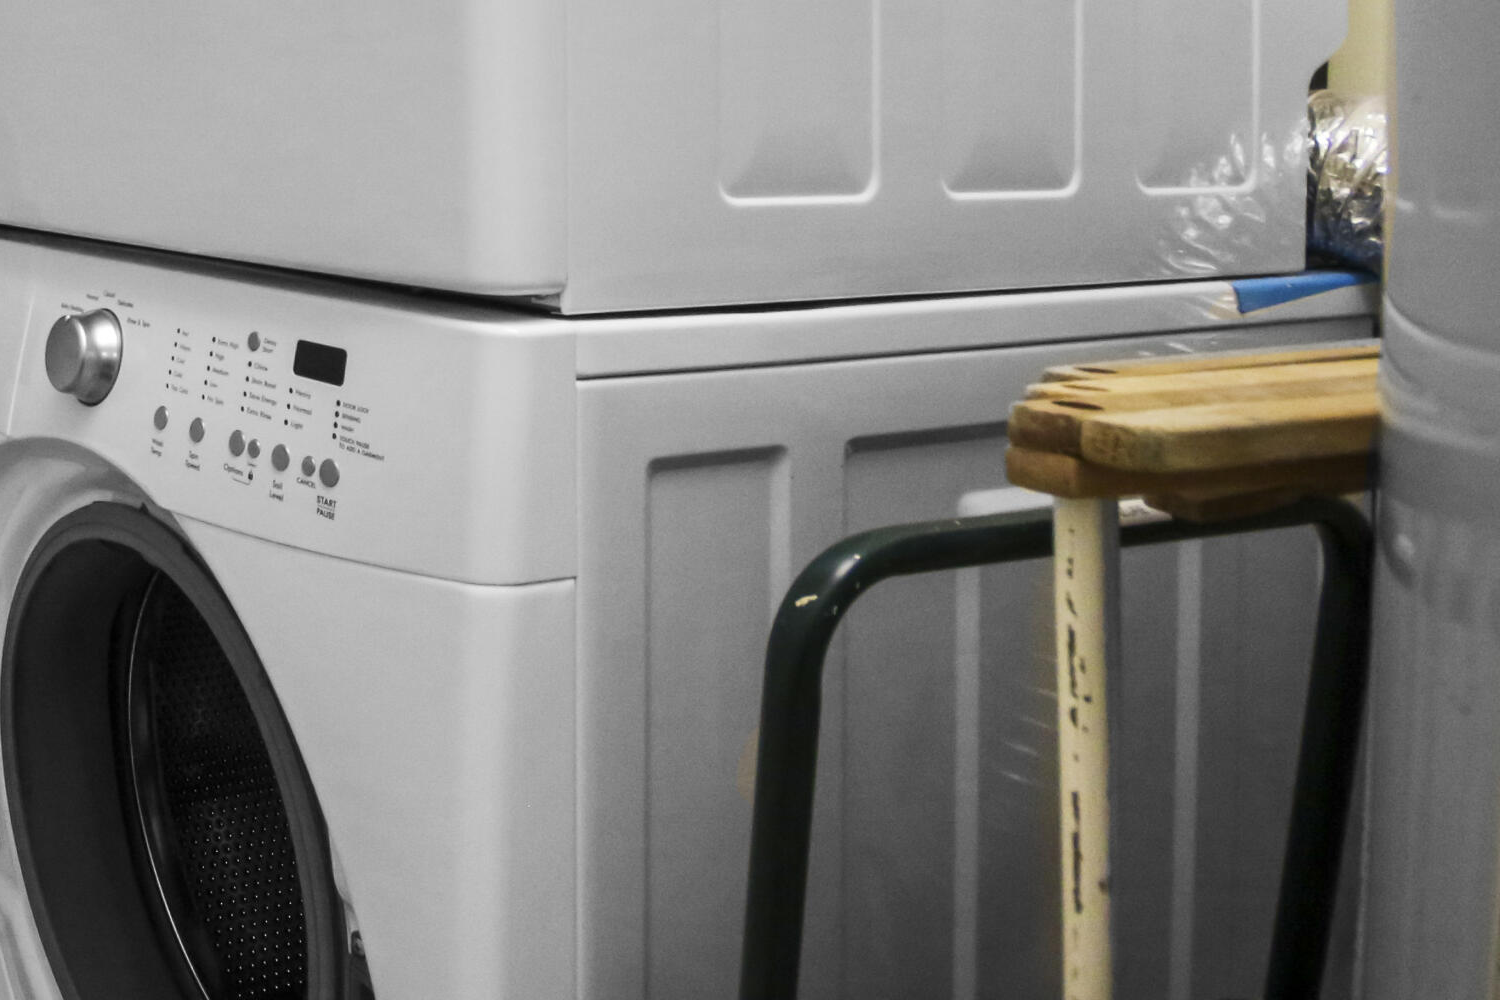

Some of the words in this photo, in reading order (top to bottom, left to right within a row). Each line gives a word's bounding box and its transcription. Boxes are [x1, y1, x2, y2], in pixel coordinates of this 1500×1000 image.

[223, 463, 244, 476] Options
[272, 479, 283, 490] Soil
[296, 477, 316, 489] CANCEL
[269, 489, 284, 502] Level
[316, 495, 337, 508] START
[316, 507, 335, 521] PAUSE
